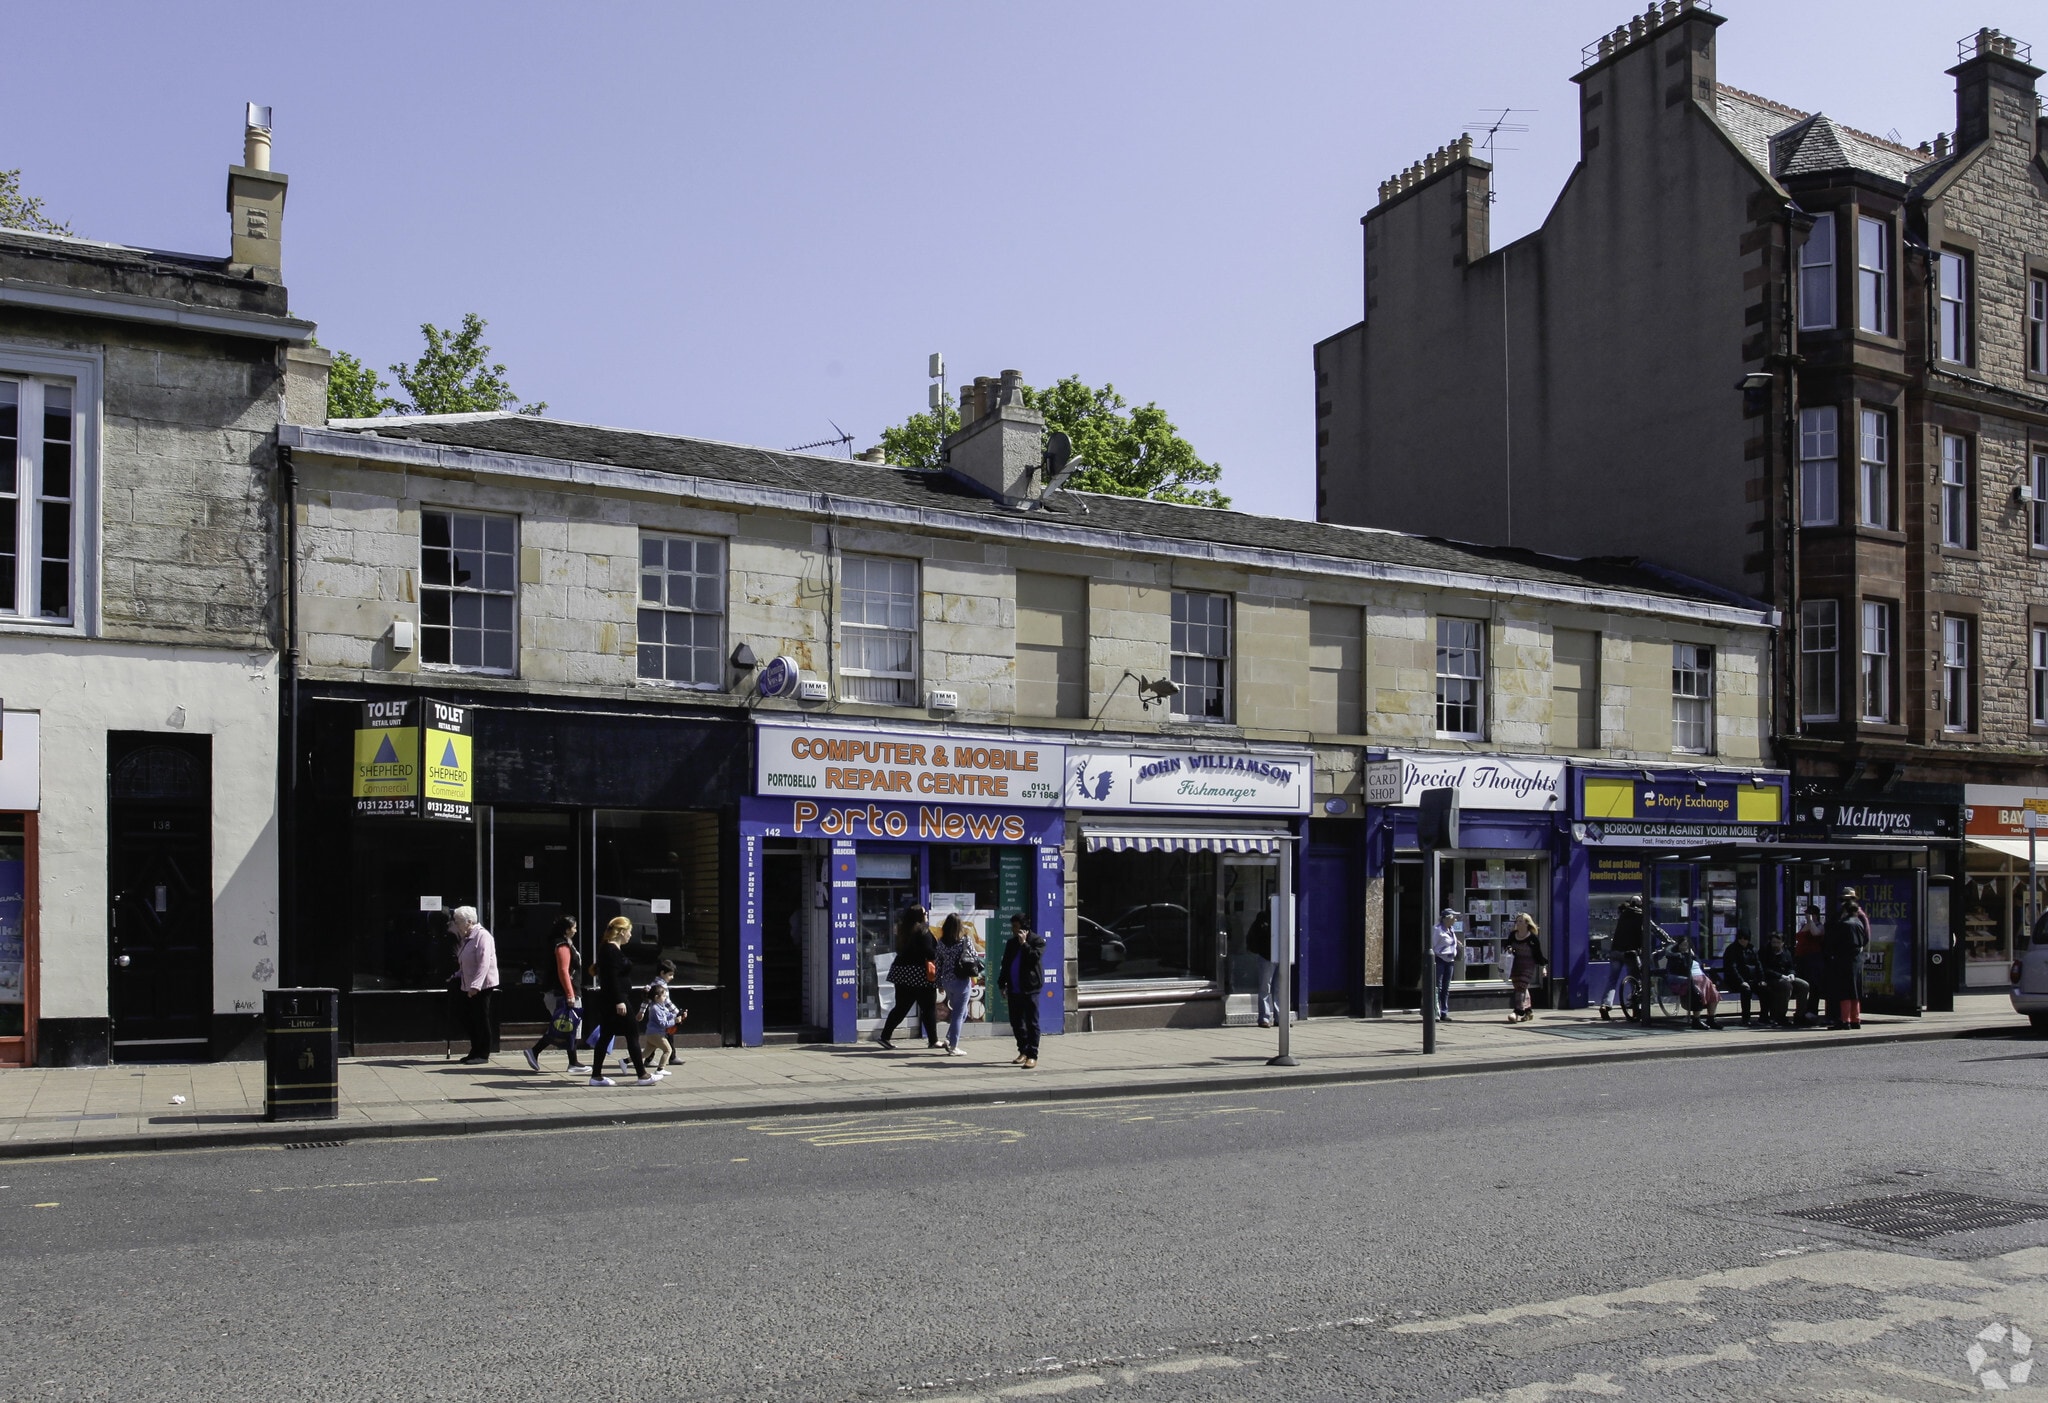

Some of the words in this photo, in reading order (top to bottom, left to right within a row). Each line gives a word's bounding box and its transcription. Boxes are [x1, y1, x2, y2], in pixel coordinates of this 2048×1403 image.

[368, 703, 384, 717] TO
[386, 701, 407, 716] LET
[434, 704, 447, 720] TO
[448, 707, 464, 723] LET
[438, 722, 451, 730] RETAIL
[792, 737, 925, 766] COMPUTER
[932, 745, 948, 766] &
[954, 747, 1038, 772] MOBILE
[360, 765, 413, 777] SHEPHERD
[429, 766, 467, 782] SHEPHERD
[1139, 758, 1181, 779] JOHN
[1188, 755, 1292, 783] WILLIAMSON
[767, 772, 817, 788] PORTOBELLO
[825, 767, 912, 792] REPAIR
[917, 772, 1008, 796] CENTRE
[1369, 774, 1396, 786] CARD
[1403, 763, 1466, 794] Special
[1473, 767, 1557, 798] Thoughts
[363, 784, 409, 794] Commercial
[432, 785, 465, 798] Commercial
[1177, 780, 1256, 802] Fishmonger
[1370, 788, 1395, 800] SHOP
[358, 801, 376, 810] 0131
[378, 801, 392, 809] 225
[395, 800, 415, 809] 1234
[428, 802, 442, 812] 0131
[444, 804, 454, 813] 225
[455, 805, 469, 814] 1234
[1658, 794, 1682, 810] Porty
[1685, 794, 1729, 812] Exchange
[794, 800, 908, 837] Porto
[920, 806, 1024, 839] News
[1836, 805, 1911, 832] McIntyres
[2001, 810, 2024, 824] BAY
[154, 820, 171, 830] 138
[765, 828, 780, 836] 142
[1604, 824, 1641, 834] BORROW
[1644, 824, 1666, 835] CASH
[1668, 825, 1704, 835] AGAINST
[1706, 825, 1727, 836] YOUR
[1730, 826, 1758, 836] MOBILE
[747, 836, 755, 867] MOBILE
[1624, 860, 1640, 868] Silver
[1873, 885, 1894, 900] THE
[1865, 902, 1907, 918] CHEESE
[1863, 952, 1884, 963] POT
